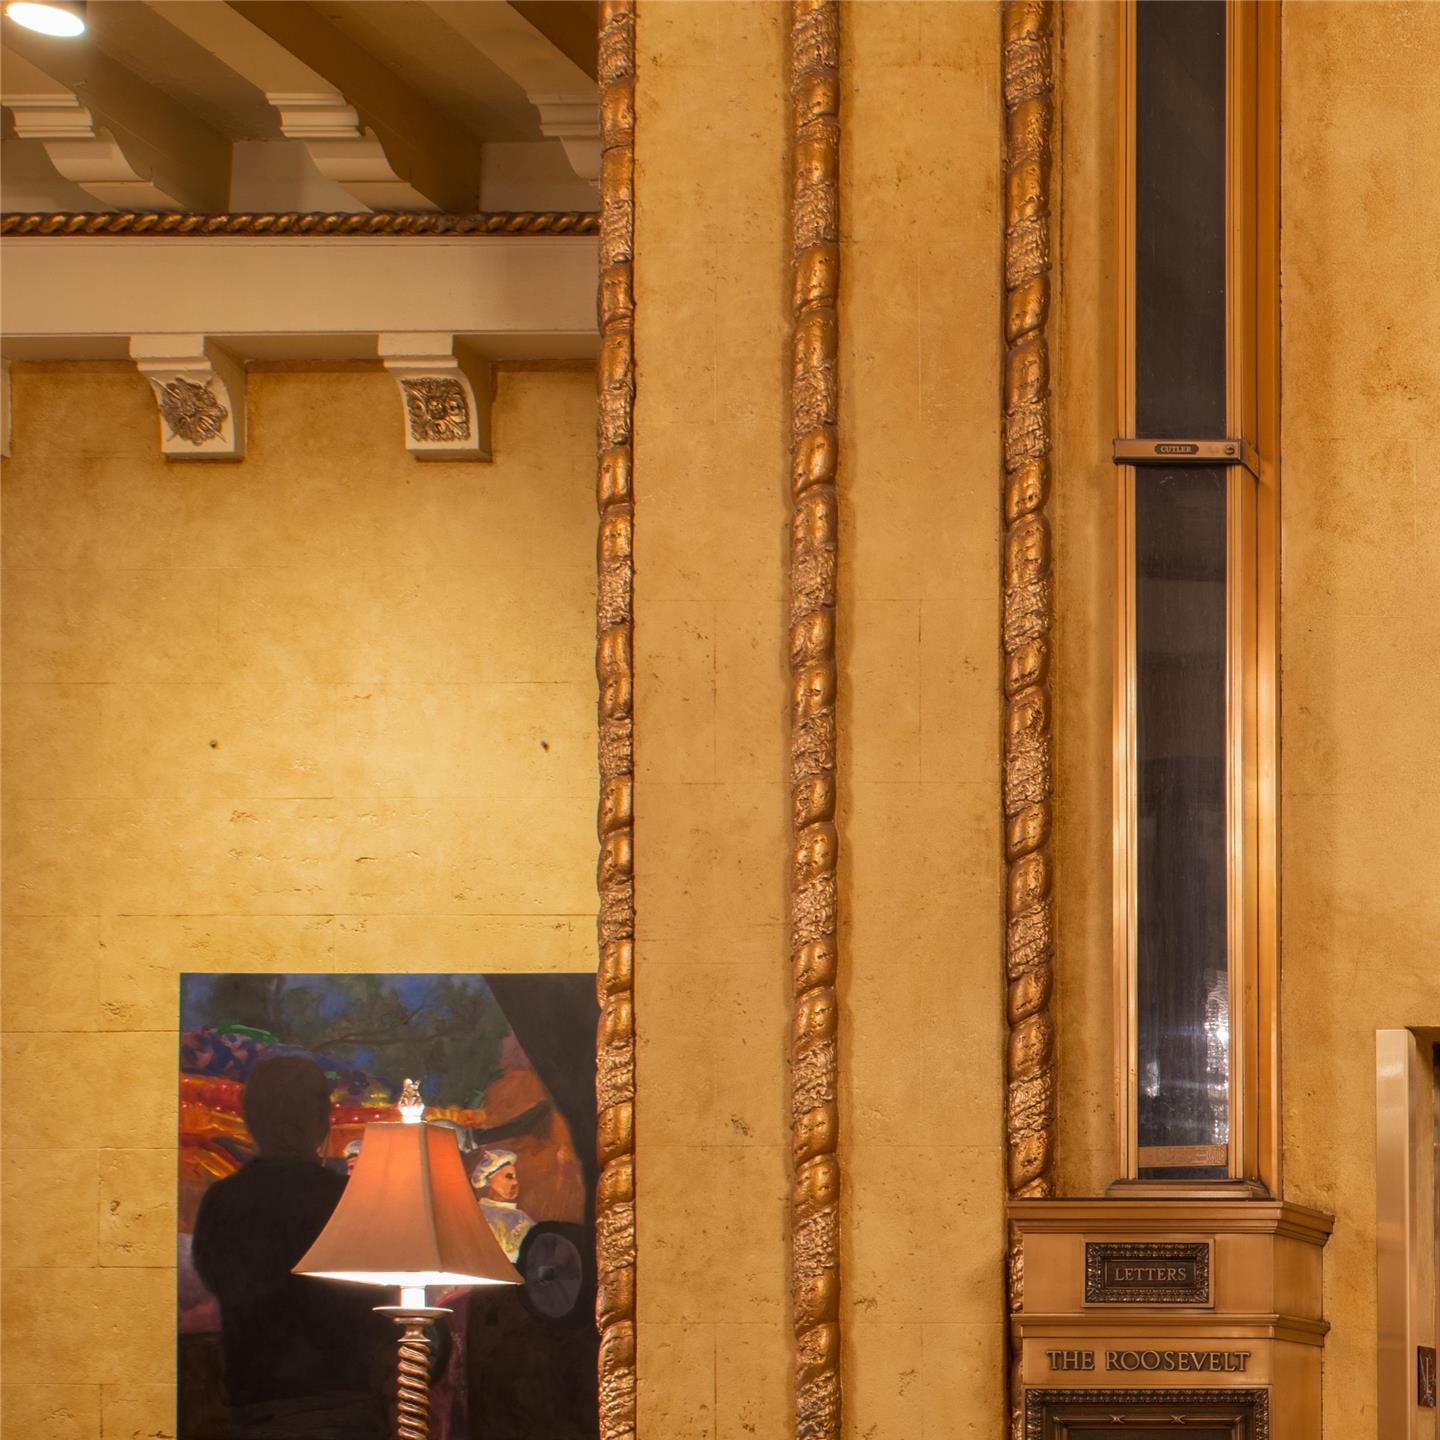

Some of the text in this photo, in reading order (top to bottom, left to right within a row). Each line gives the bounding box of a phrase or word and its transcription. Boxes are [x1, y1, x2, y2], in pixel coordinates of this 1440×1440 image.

[1114, 1267, 1187, 1281] LETTERS
[1047, 1350, 1250, 1372] THE ROOSEVELT
